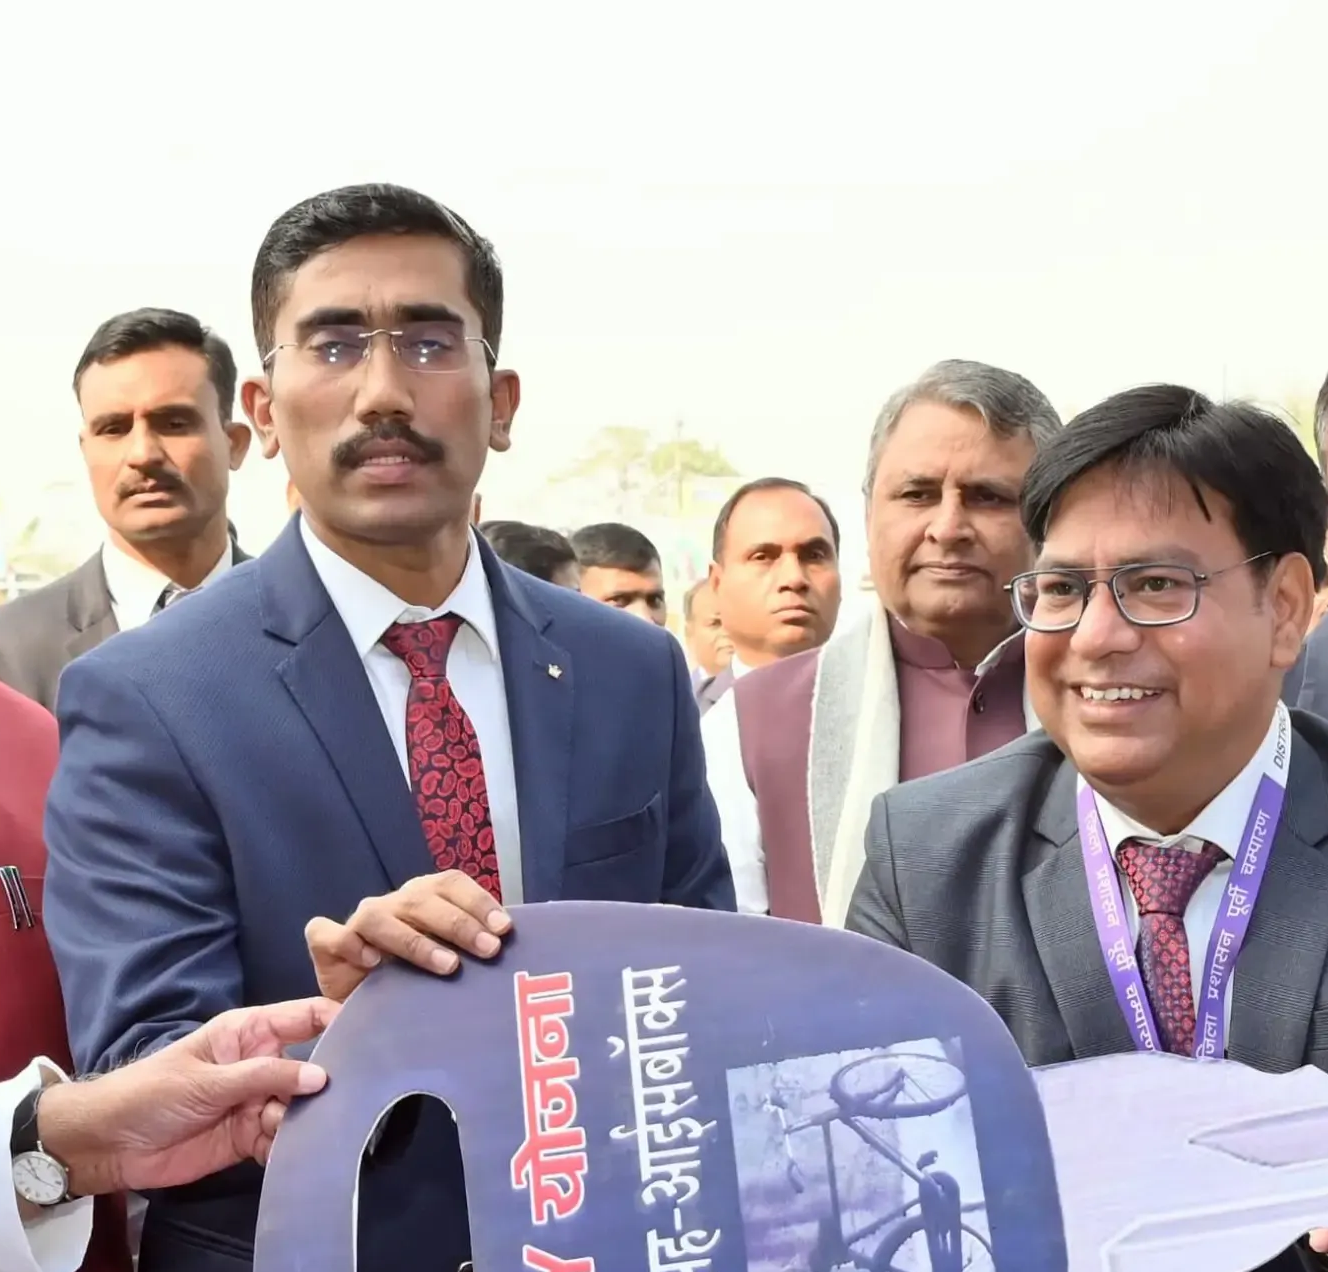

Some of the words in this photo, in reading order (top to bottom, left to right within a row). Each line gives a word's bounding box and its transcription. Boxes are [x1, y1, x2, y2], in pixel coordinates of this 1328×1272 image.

[1273, 706, 1287, 770] DISTRI
[1085, 808, 1104, 856] जिला
[1095, 863, 1120, 928] प्रशासन
[1107, 937, 1136, 973] पूर्वी
[1195, 1012, 1218, 1060] जिला
[1208, 928, 1236, 1000] प्रशासन
[1227, 883, 1250, 917] पूर्वी
[1240, 808, 1271, 876] चम्पारण
[511, 968, 587, 1225] योजना
